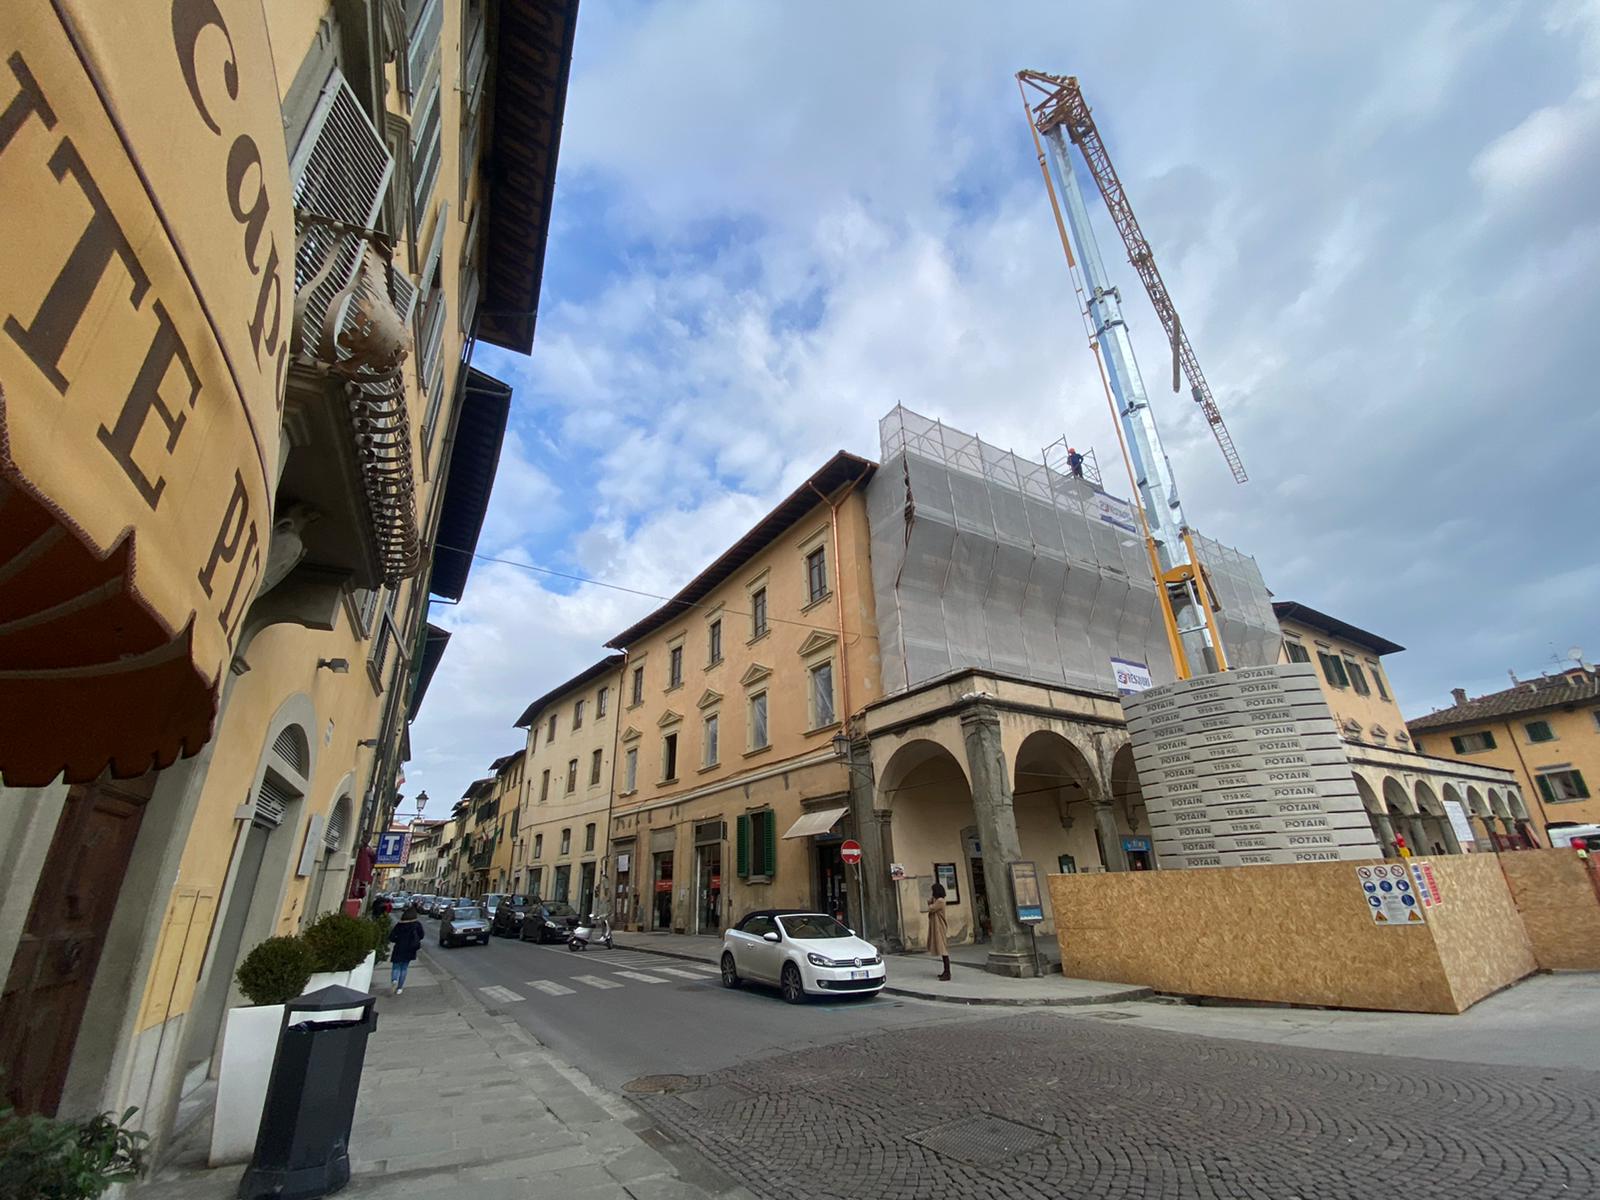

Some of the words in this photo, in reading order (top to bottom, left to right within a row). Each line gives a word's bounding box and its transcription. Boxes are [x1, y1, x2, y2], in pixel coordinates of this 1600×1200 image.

[1236, 670, 1273, 680] POTAIN
[1240, 684, 1278, 693] POTAIN
[1246, 697, 1284, 707] POTAIN
[1251, 712, 1289, 721] POTAIN
[1255, 727, 1293, 736] POTAIN
[1157, 741, 1187, 750] POTAIN
[1259, 741, 1298, 750] POTAIN
[1264, 756, 1304, 765] POTAIN
[1164, 769, 1194, 778] POTAIN
[1269, 772, 1309, 781] POTAIN
[1168, 783, 1198, 792] POTAIN
[1274, 788, 1314, 796] POTAIN
[1171, 798, 1202, 807] POTAIN
[1279, 803, 1320, 812] POTAIN
[1175, 812, 1206, 821] POTAIN
[1285, 820, 1326, 828] POTAIN
[1179, 827, 1211, 836] POTAIN
[1289, 836, 1330, 845] POTAIN
[385, 836, 400, 855] T
[1183, 843, 1215, 851] POTAIN
[1296, 853, 1338, 861] POTAIN
[1187, 858, 1220, 866] POTAIN
